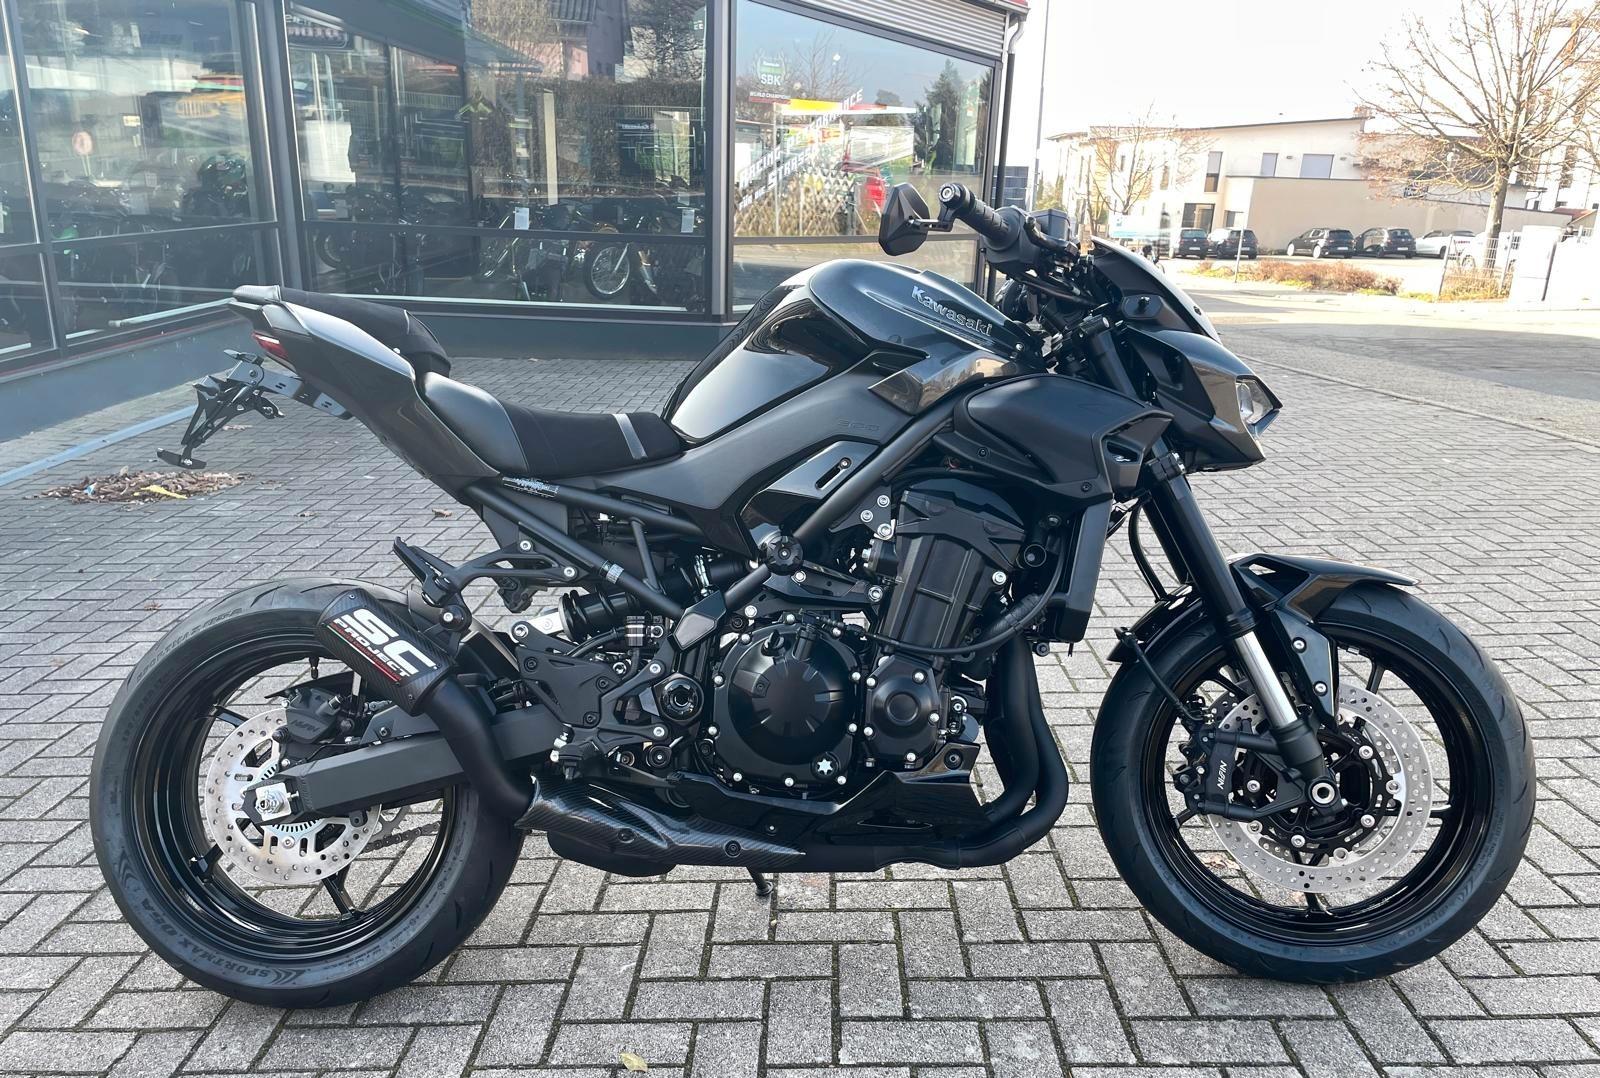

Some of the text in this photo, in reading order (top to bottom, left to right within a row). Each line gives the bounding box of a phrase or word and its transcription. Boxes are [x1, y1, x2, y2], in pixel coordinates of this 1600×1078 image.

[760, 73, 781, 86] SBK
[911, 285, 993, 337] Kawasaki
[333, 617, 411, 677] PROJECT
[340, 608, 437, 675] SC
[177, 936, 272, 979] SPORTMAX
